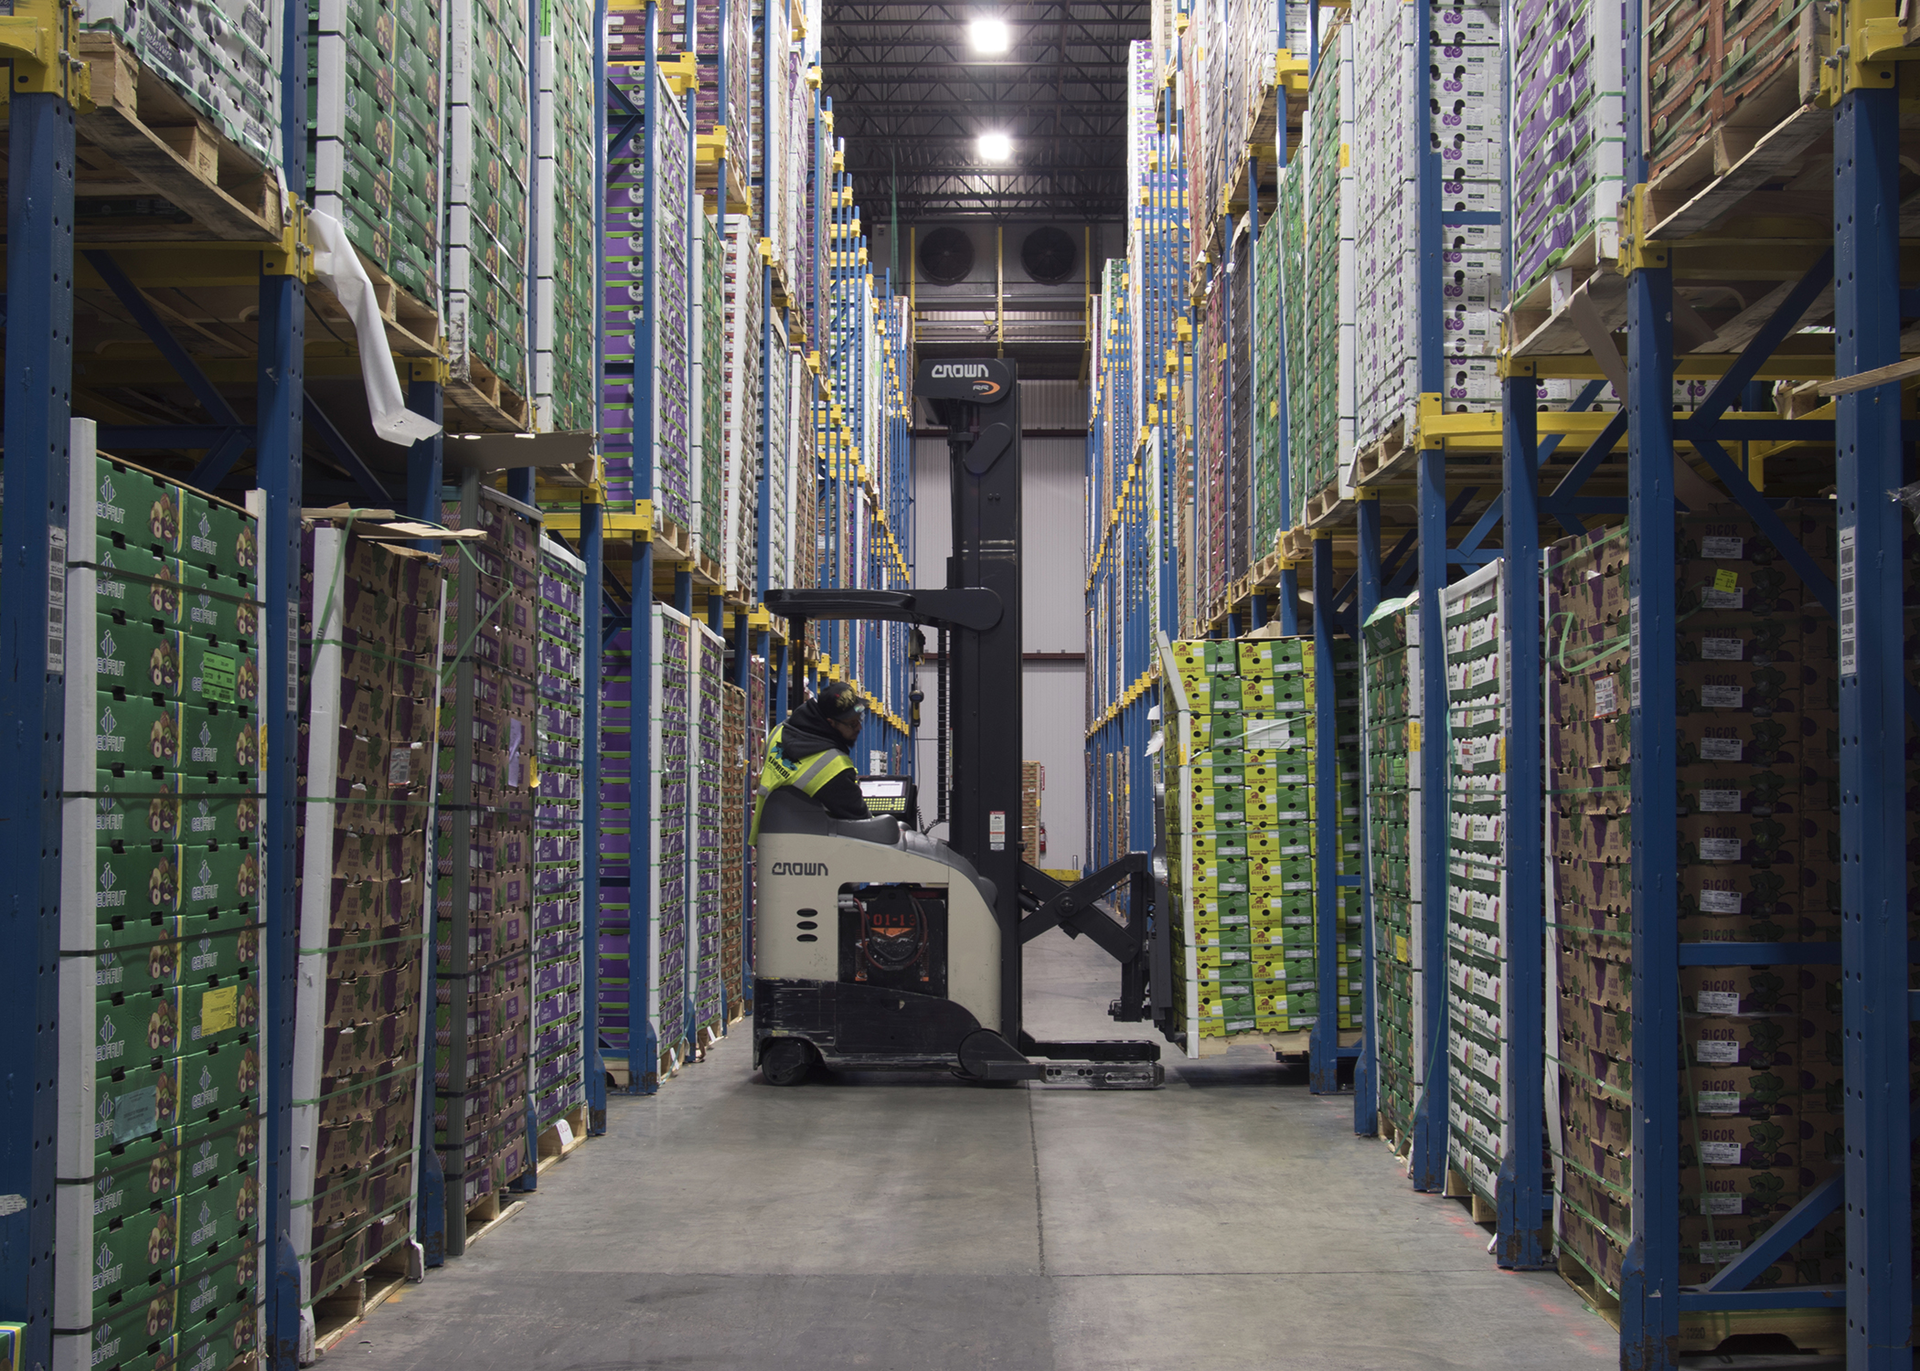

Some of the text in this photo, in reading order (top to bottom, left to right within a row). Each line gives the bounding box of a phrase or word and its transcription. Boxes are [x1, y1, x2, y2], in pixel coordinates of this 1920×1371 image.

[932, 364, 989, 378] CROWN
[1706, 524, 1738, 536] SICOR
[1704, 627, 1738, 638] SICOR
[1704, 674, 1738, 686] SICOR
[1704, 727, 1738, 738] SICOR
[1704, 778, 1736, 790] SICOR
[1704, 826, 1737, 838] SICOR
[772, 862, 828, 876] CROWN
[1703, 879, 1736, 891] SICOR
[1703, 930, 1736, 941] SICOR
[1702, 980, 1736, 992] SICOR
[1702, 1029, 1735, 1040] SICOR
[1702, 1080, 1735, 1092] SICOR
[1702, 1130, 1735, 1141] SICOR
